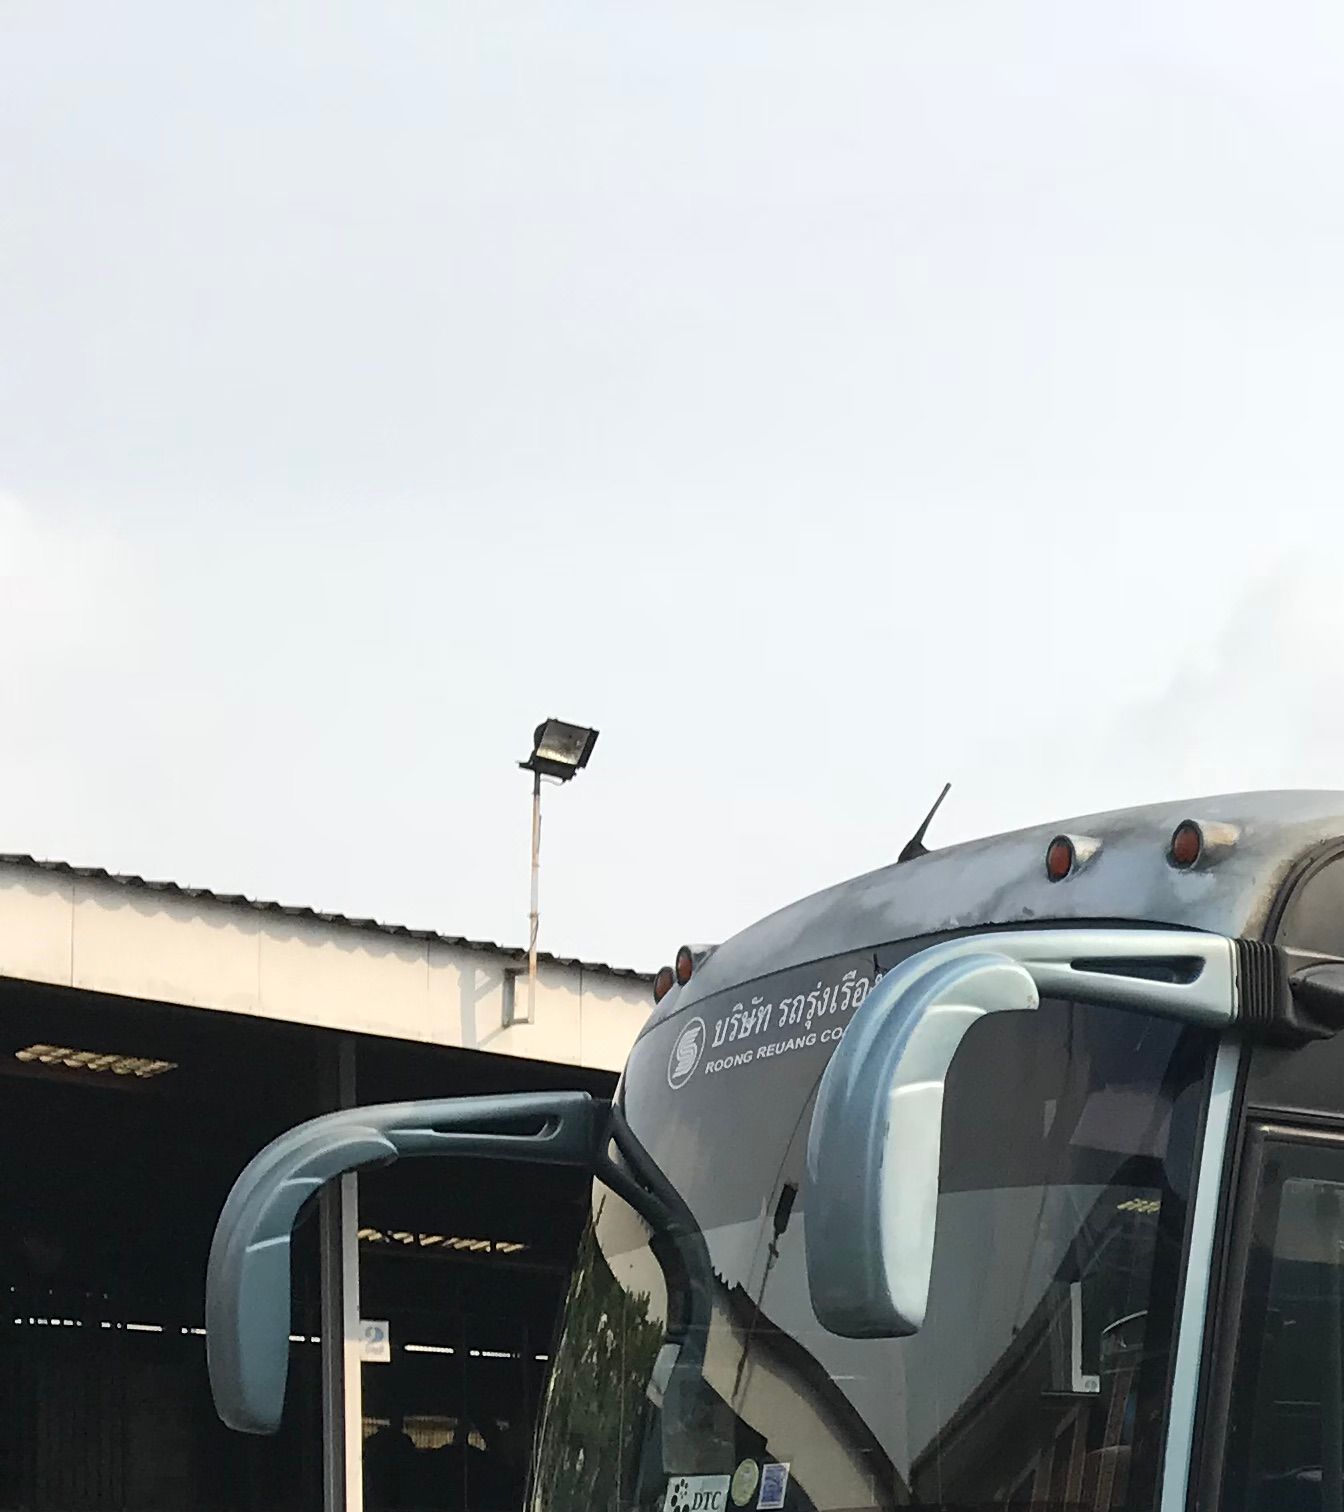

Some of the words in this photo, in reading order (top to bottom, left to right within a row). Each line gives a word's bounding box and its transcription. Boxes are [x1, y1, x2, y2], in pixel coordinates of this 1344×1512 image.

[711, 996, 772, 1048] บริษัท
[704, 1050, 753, 1074] ROONG
[756, 1033, 816, 1059] REUANG
[691, 1491, 722, 1511] DTC
